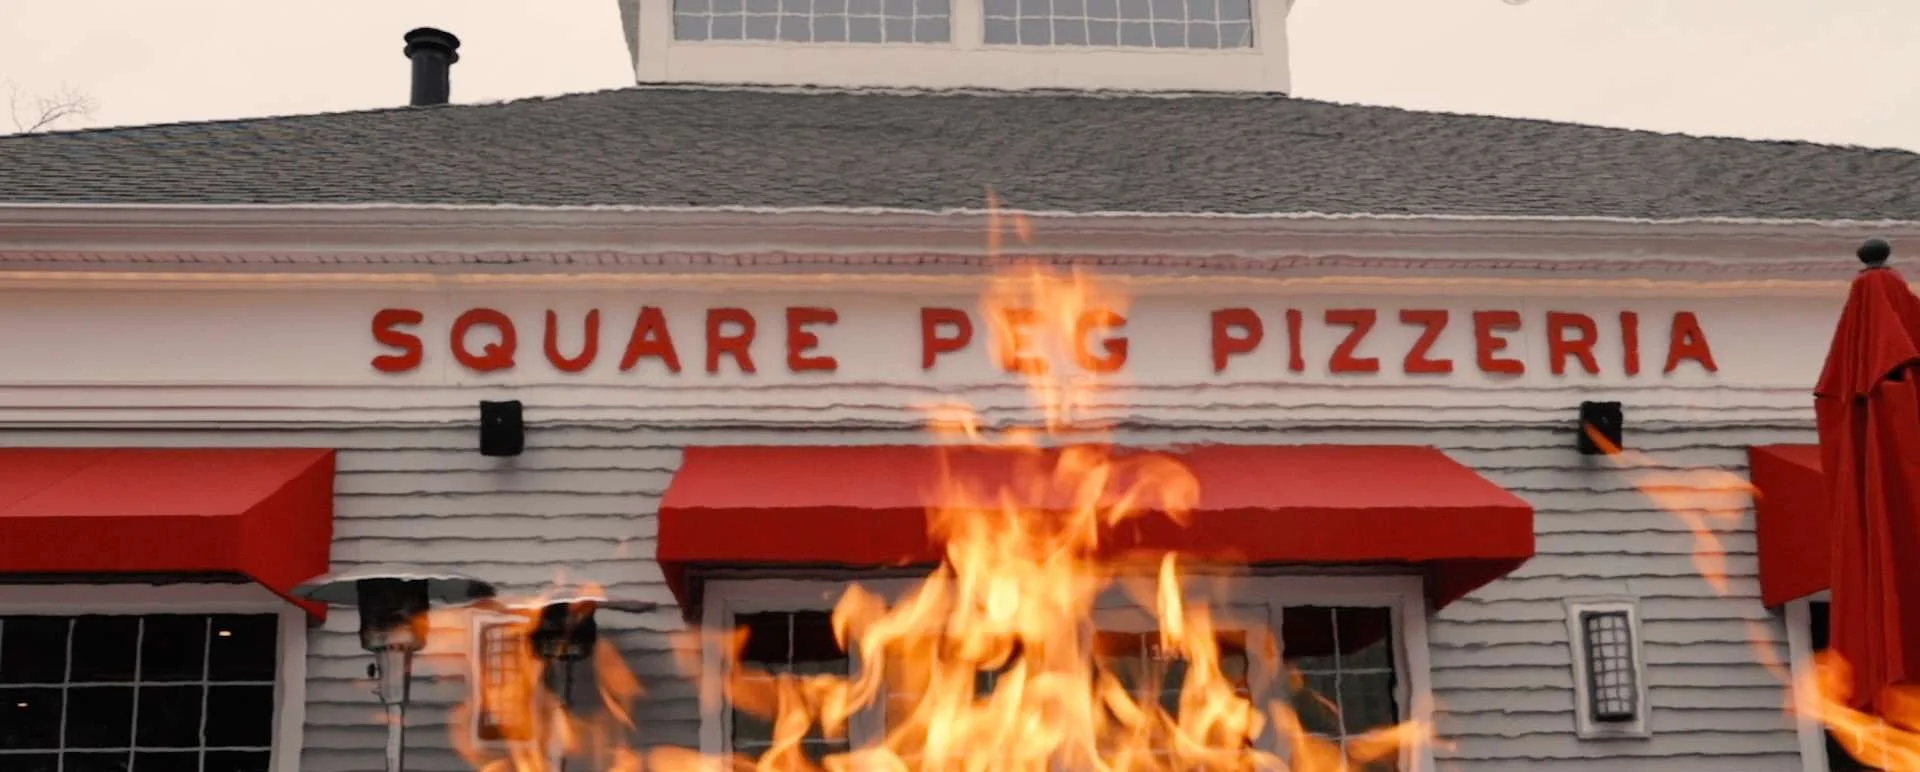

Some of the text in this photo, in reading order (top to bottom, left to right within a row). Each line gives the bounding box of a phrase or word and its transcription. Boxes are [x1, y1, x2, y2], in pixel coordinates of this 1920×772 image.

[370, 306, 1718, 375] SQUARE PEG PIZZERIA
